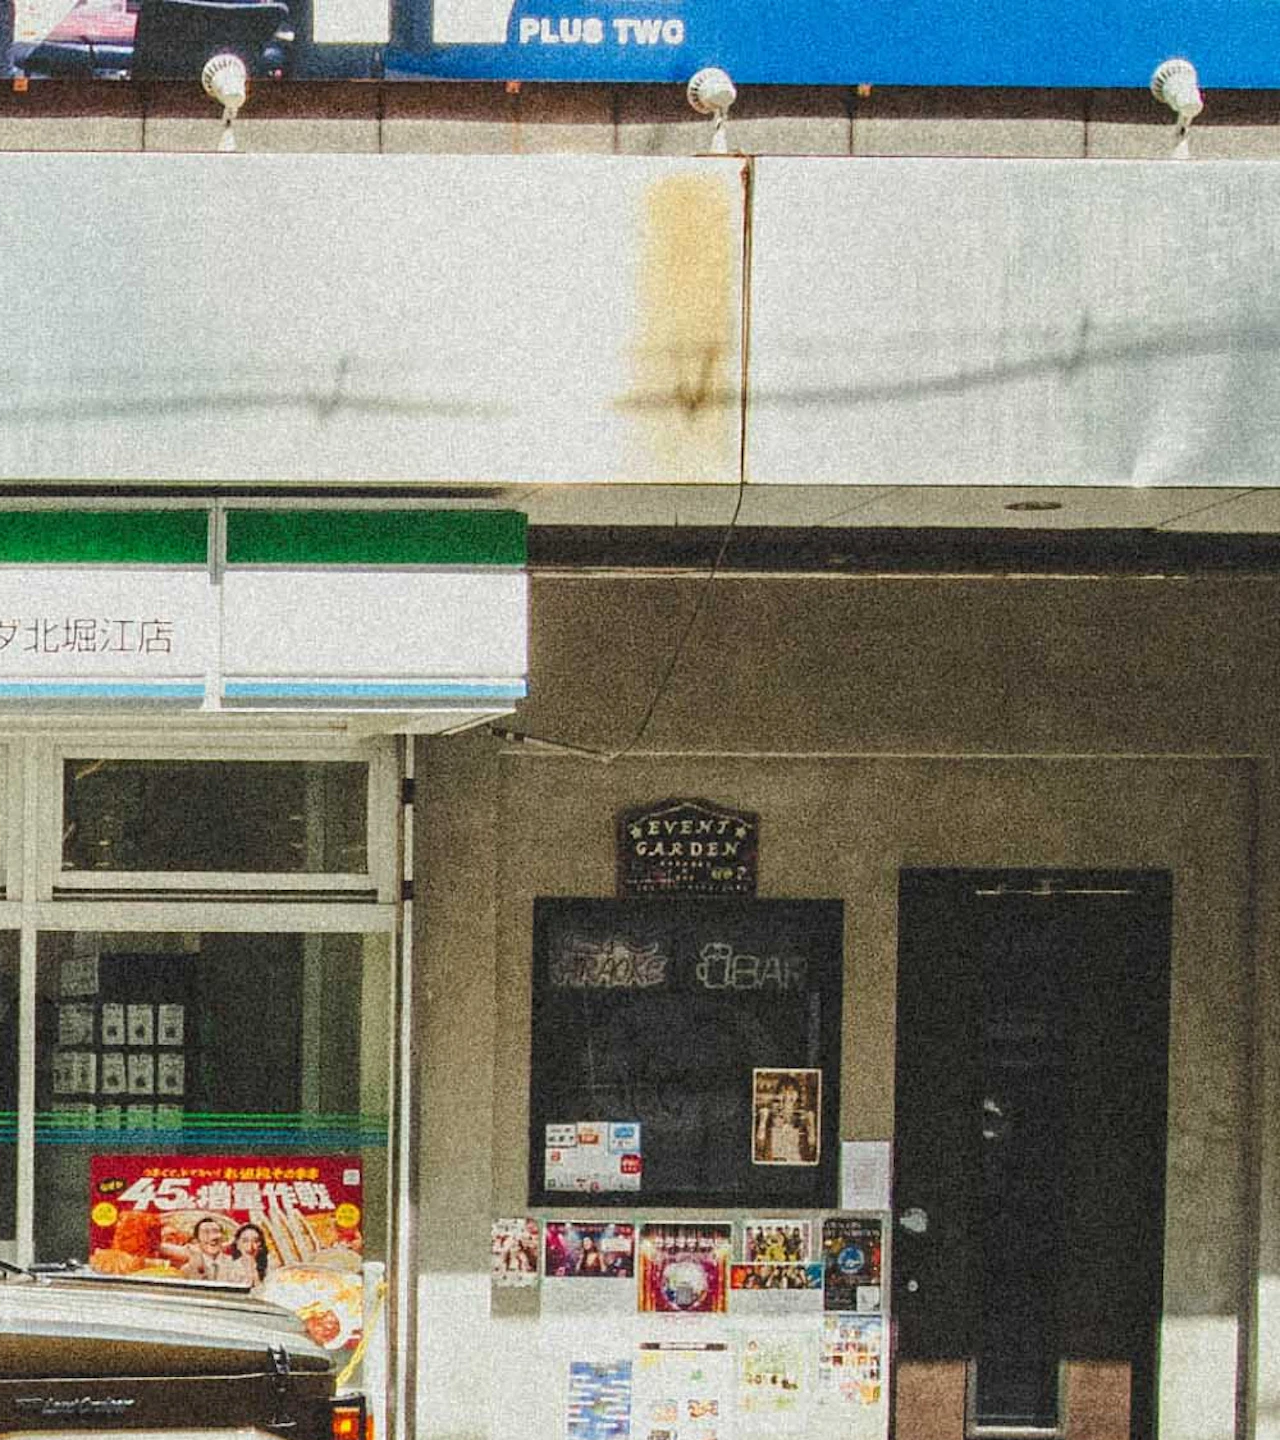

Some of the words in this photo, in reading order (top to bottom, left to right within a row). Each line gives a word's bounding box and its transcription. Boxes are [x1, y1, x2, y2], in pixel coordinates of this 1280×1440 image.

[519, 17, 604, 44] PLUS
[612, 19, 685, 45] TWO
[647, 819, 730, 836] EVENT
[635, 841, 740, 857] GARDEN
